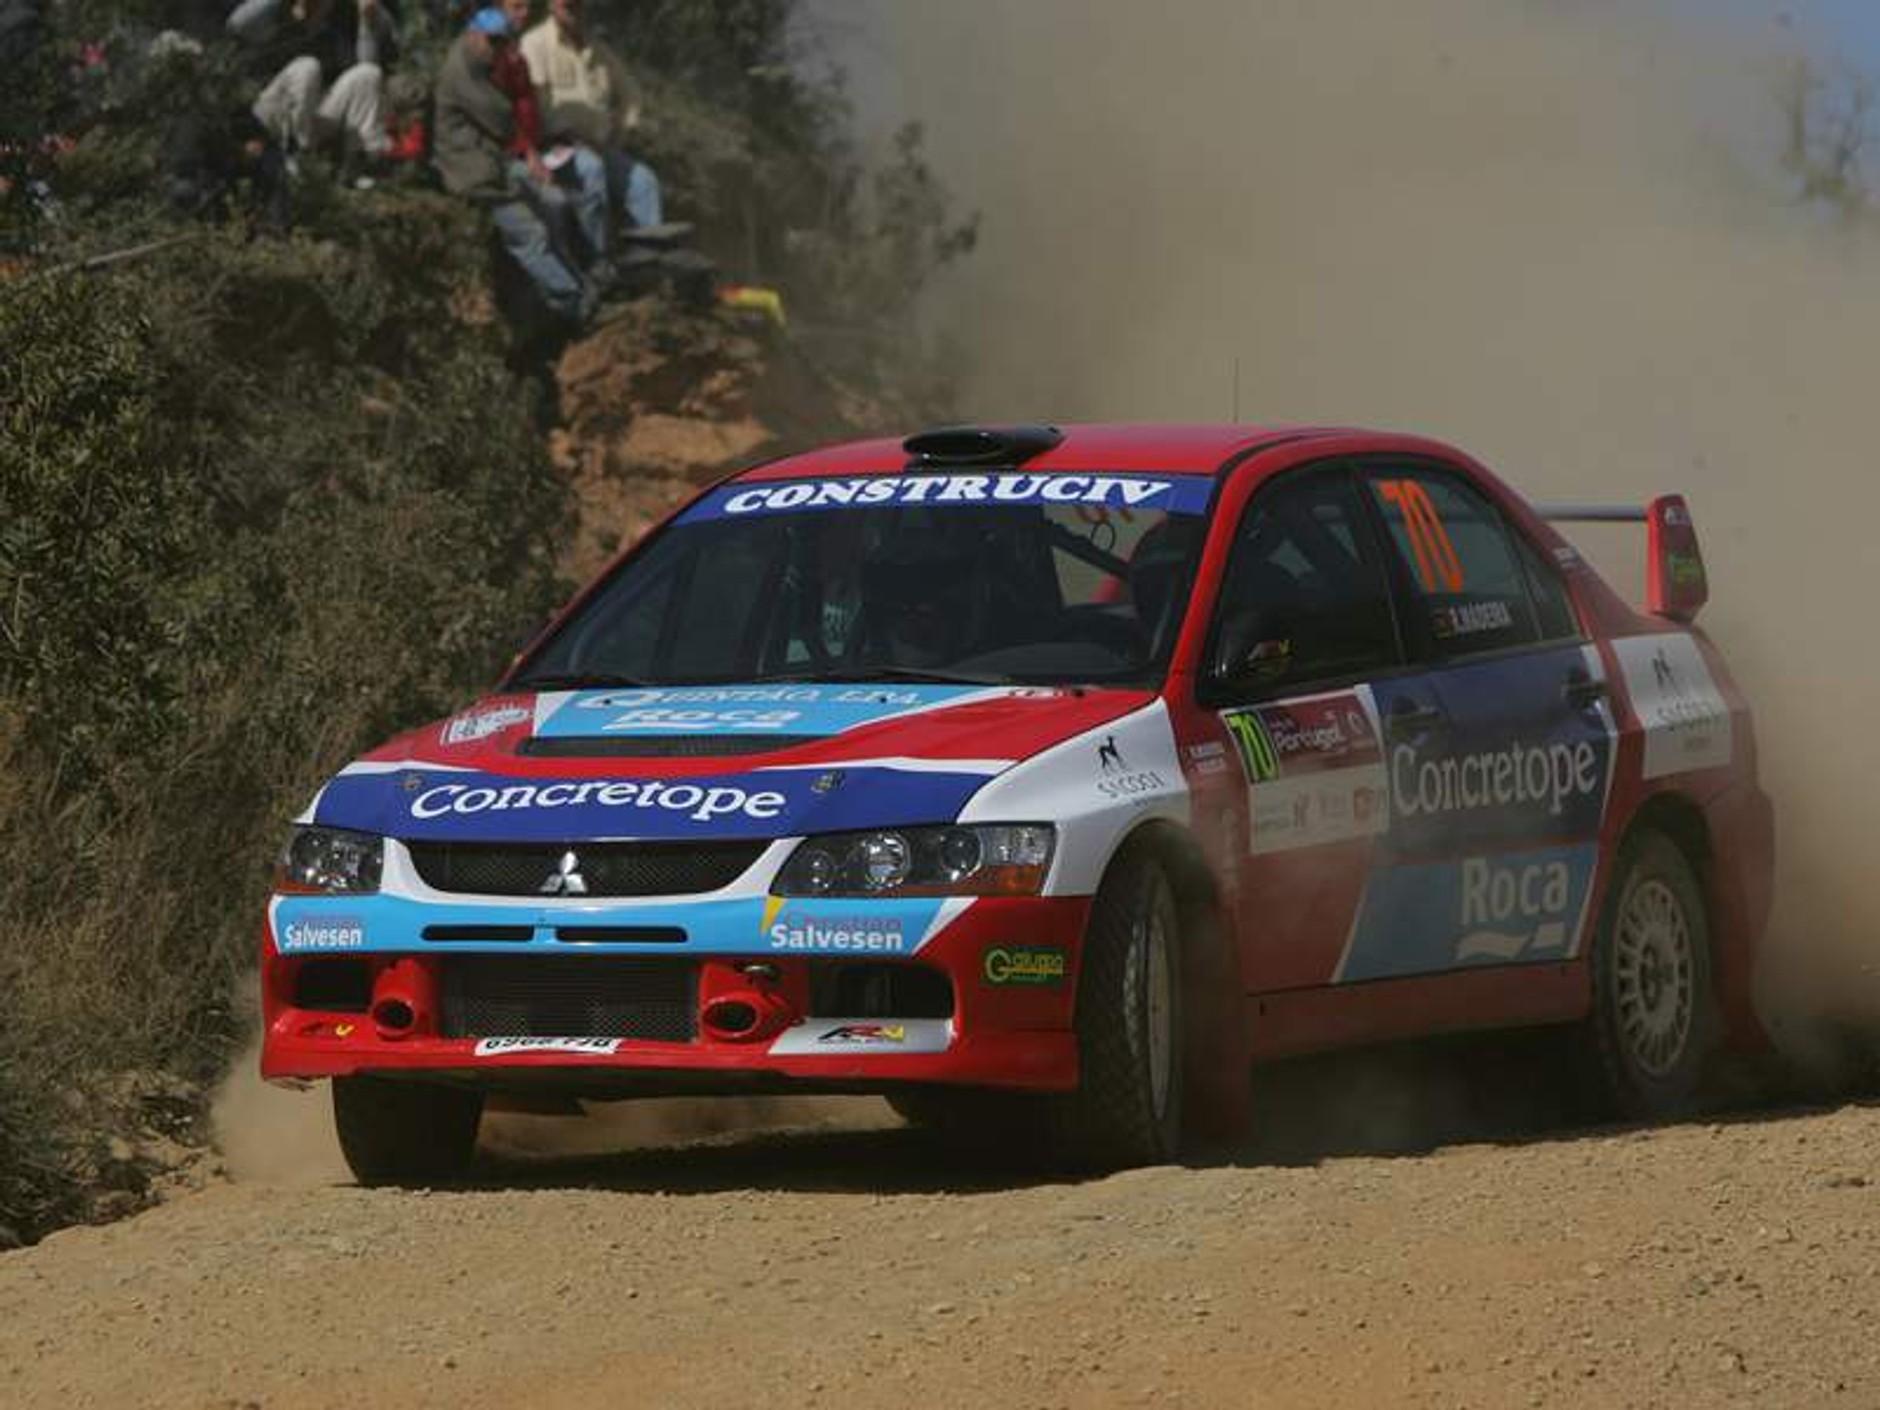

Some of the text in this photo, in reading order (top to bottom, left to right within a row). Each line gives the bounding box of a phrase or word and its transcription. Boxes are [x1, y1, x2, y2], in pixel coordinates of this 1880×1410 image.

[724, 475, 1174, 513] CONSTRUCIV
[1376, 479, 1464, 595] 70
[1225, 713, 1279, 783] 70
[410, 779, 787, 821] Concretope
[1392, 741, 1598, 816] Concretope
[1461, 857, 1569, 926] Roca
[283, 922, 363, 949] Salvesen
[770, 922, 903, 950] Salvesen
